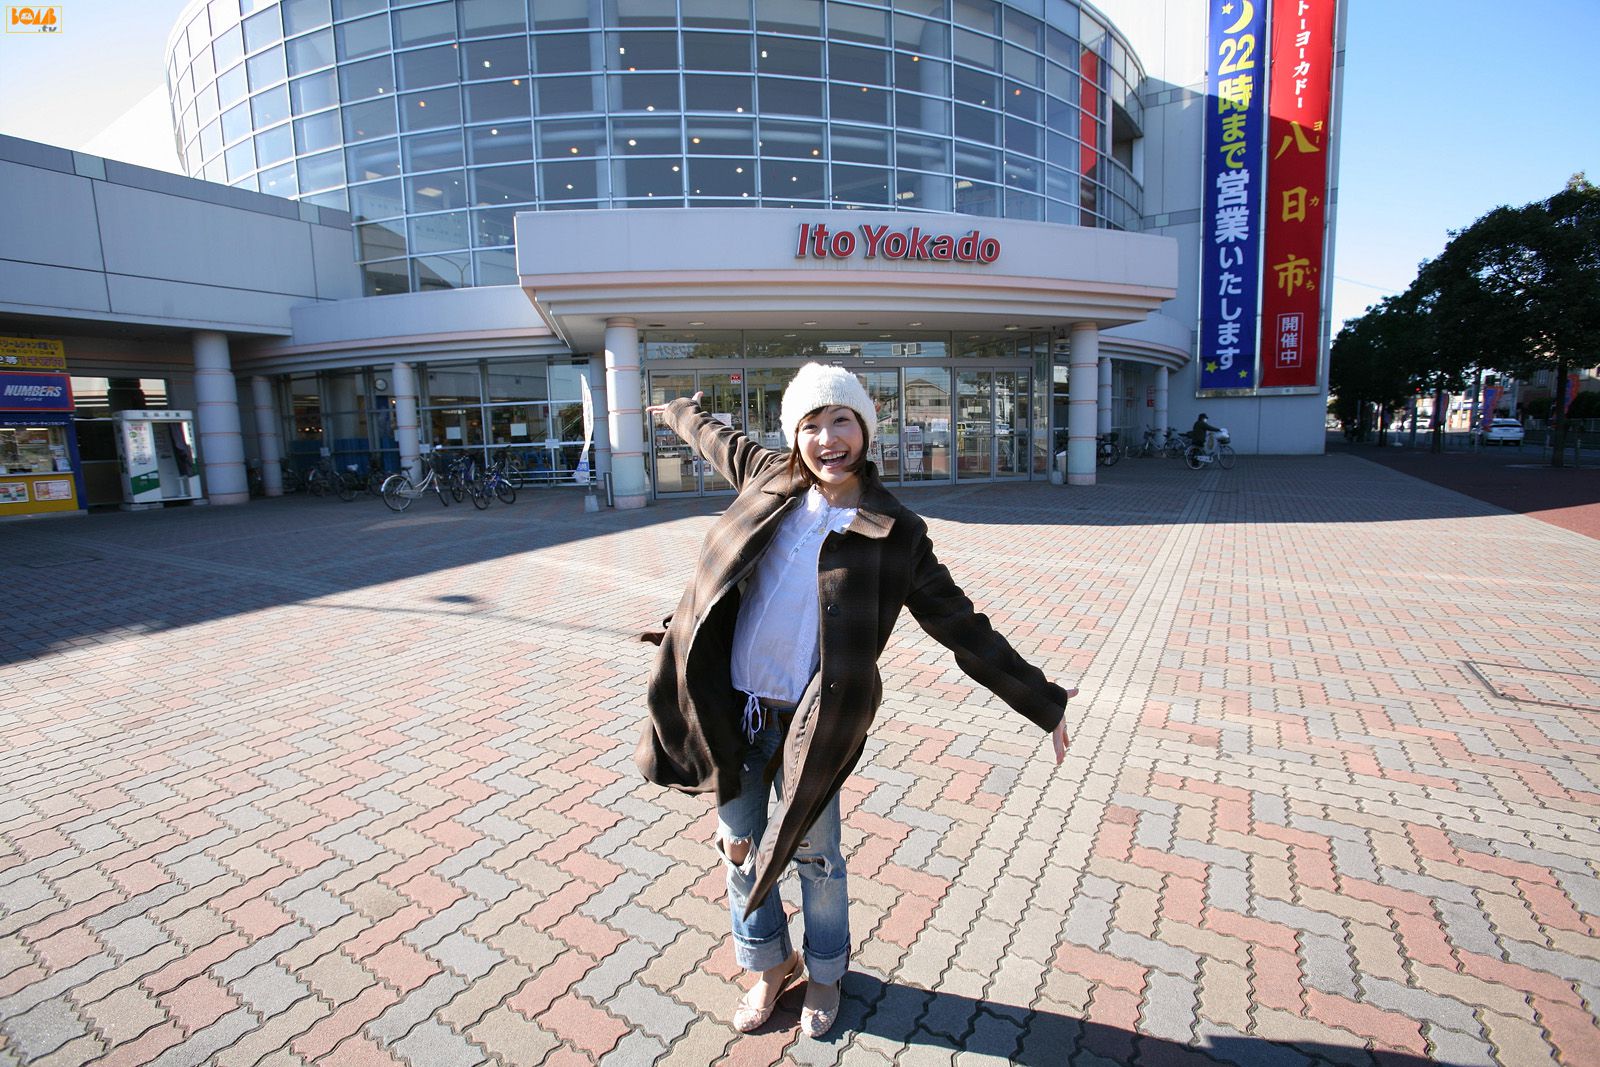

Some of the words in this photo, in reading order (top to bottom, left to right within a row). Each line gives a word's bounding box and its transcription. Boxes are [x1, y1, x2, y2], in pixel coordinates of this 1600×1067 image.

[1292, 0, 1311, 109] トーヨーカドー
[1214, 34, 1256, 370] 22時まで営業いたします
[1273, 120, 1320, 297] 八日市
[795, 223, 857, 258] Ito
[858, 224, 1001, 264] Yokado
[1280, 315, 1299, 365] 開催中
[3, 384, 63, 397] NUMBERS
